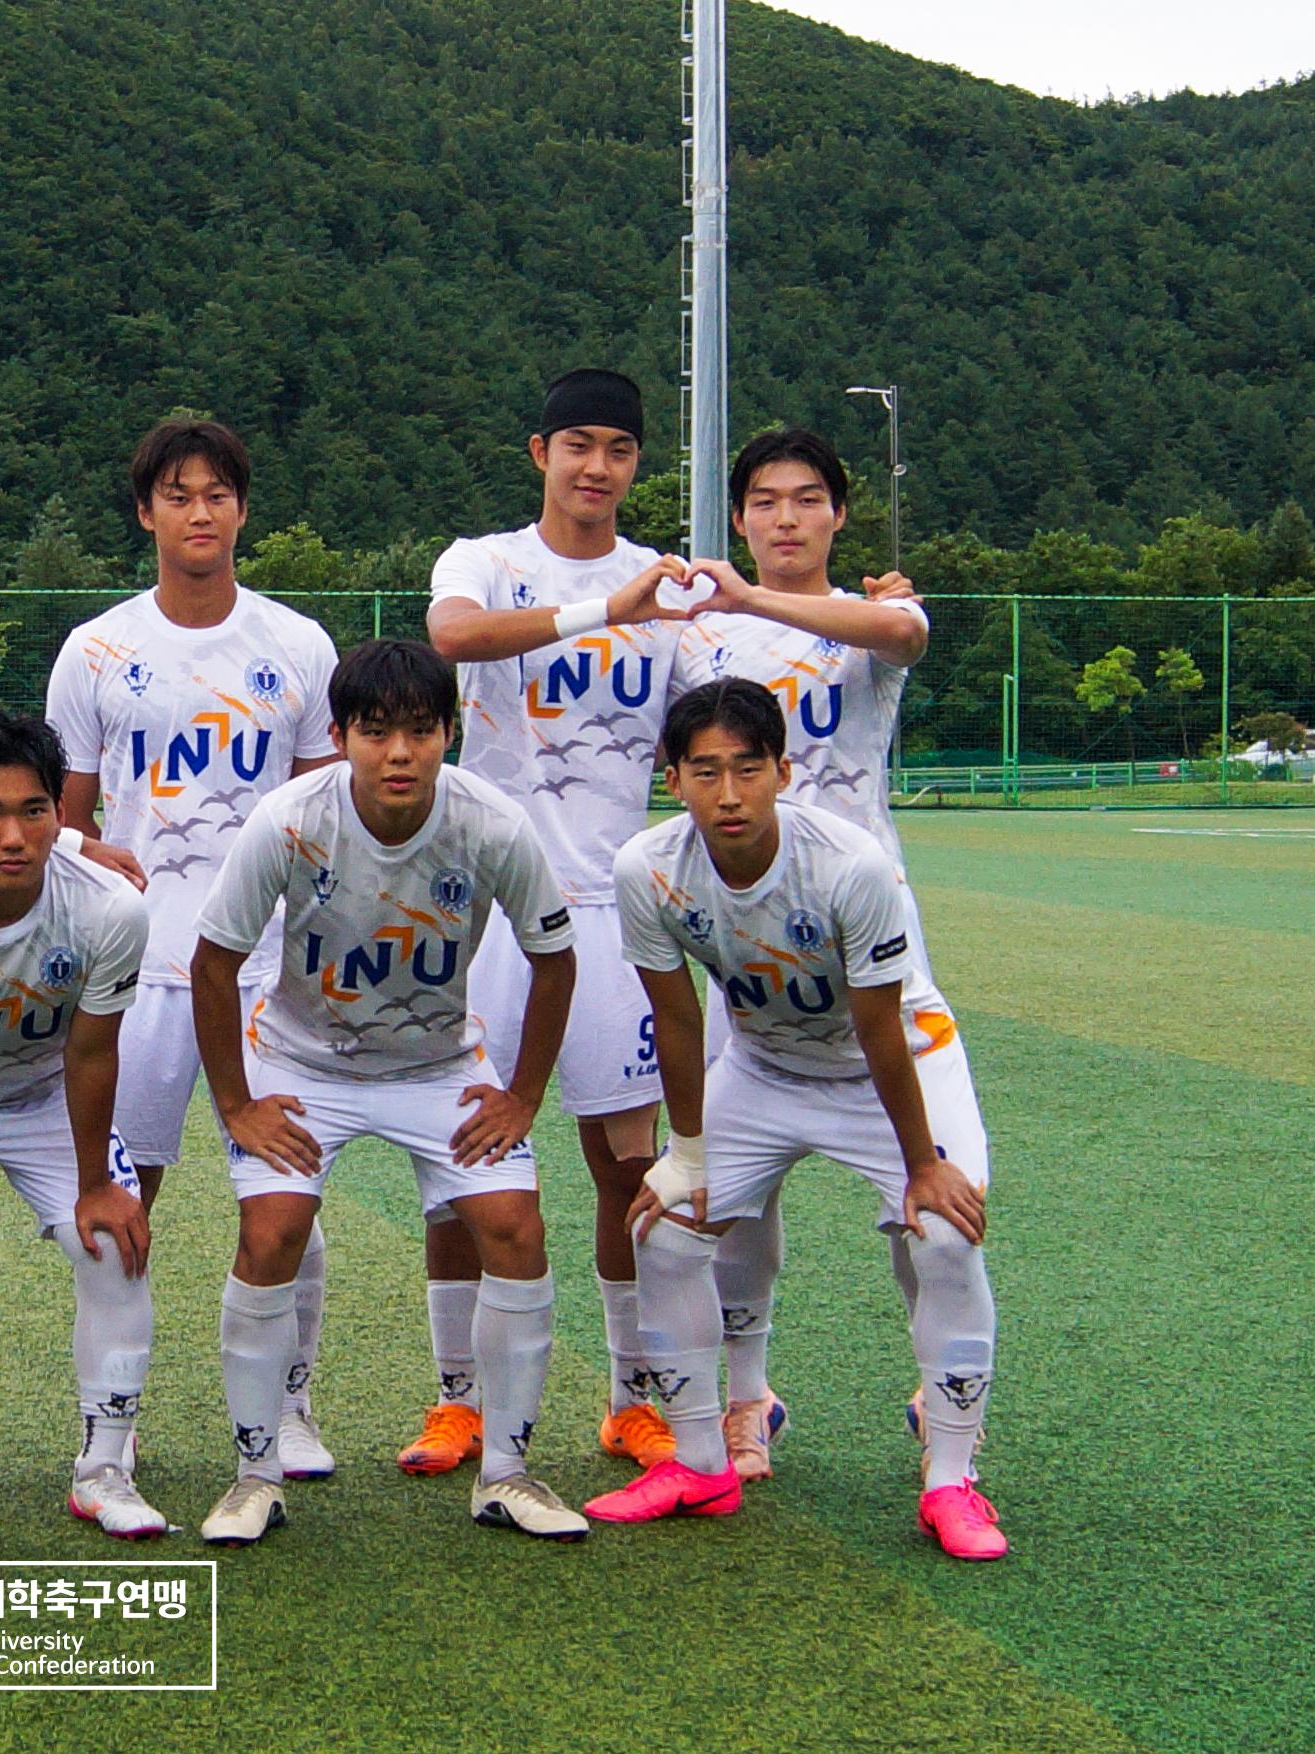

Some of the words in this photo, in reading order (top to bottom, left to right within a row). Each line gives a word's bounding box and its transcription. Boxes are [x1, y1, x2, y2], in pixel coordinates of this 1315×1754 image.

[518, 652, 652, 708] NU
[131, 728, 272, 782] INU
[305, 930, 461, 990] INU
[703, 960, 836, 1016] NU
